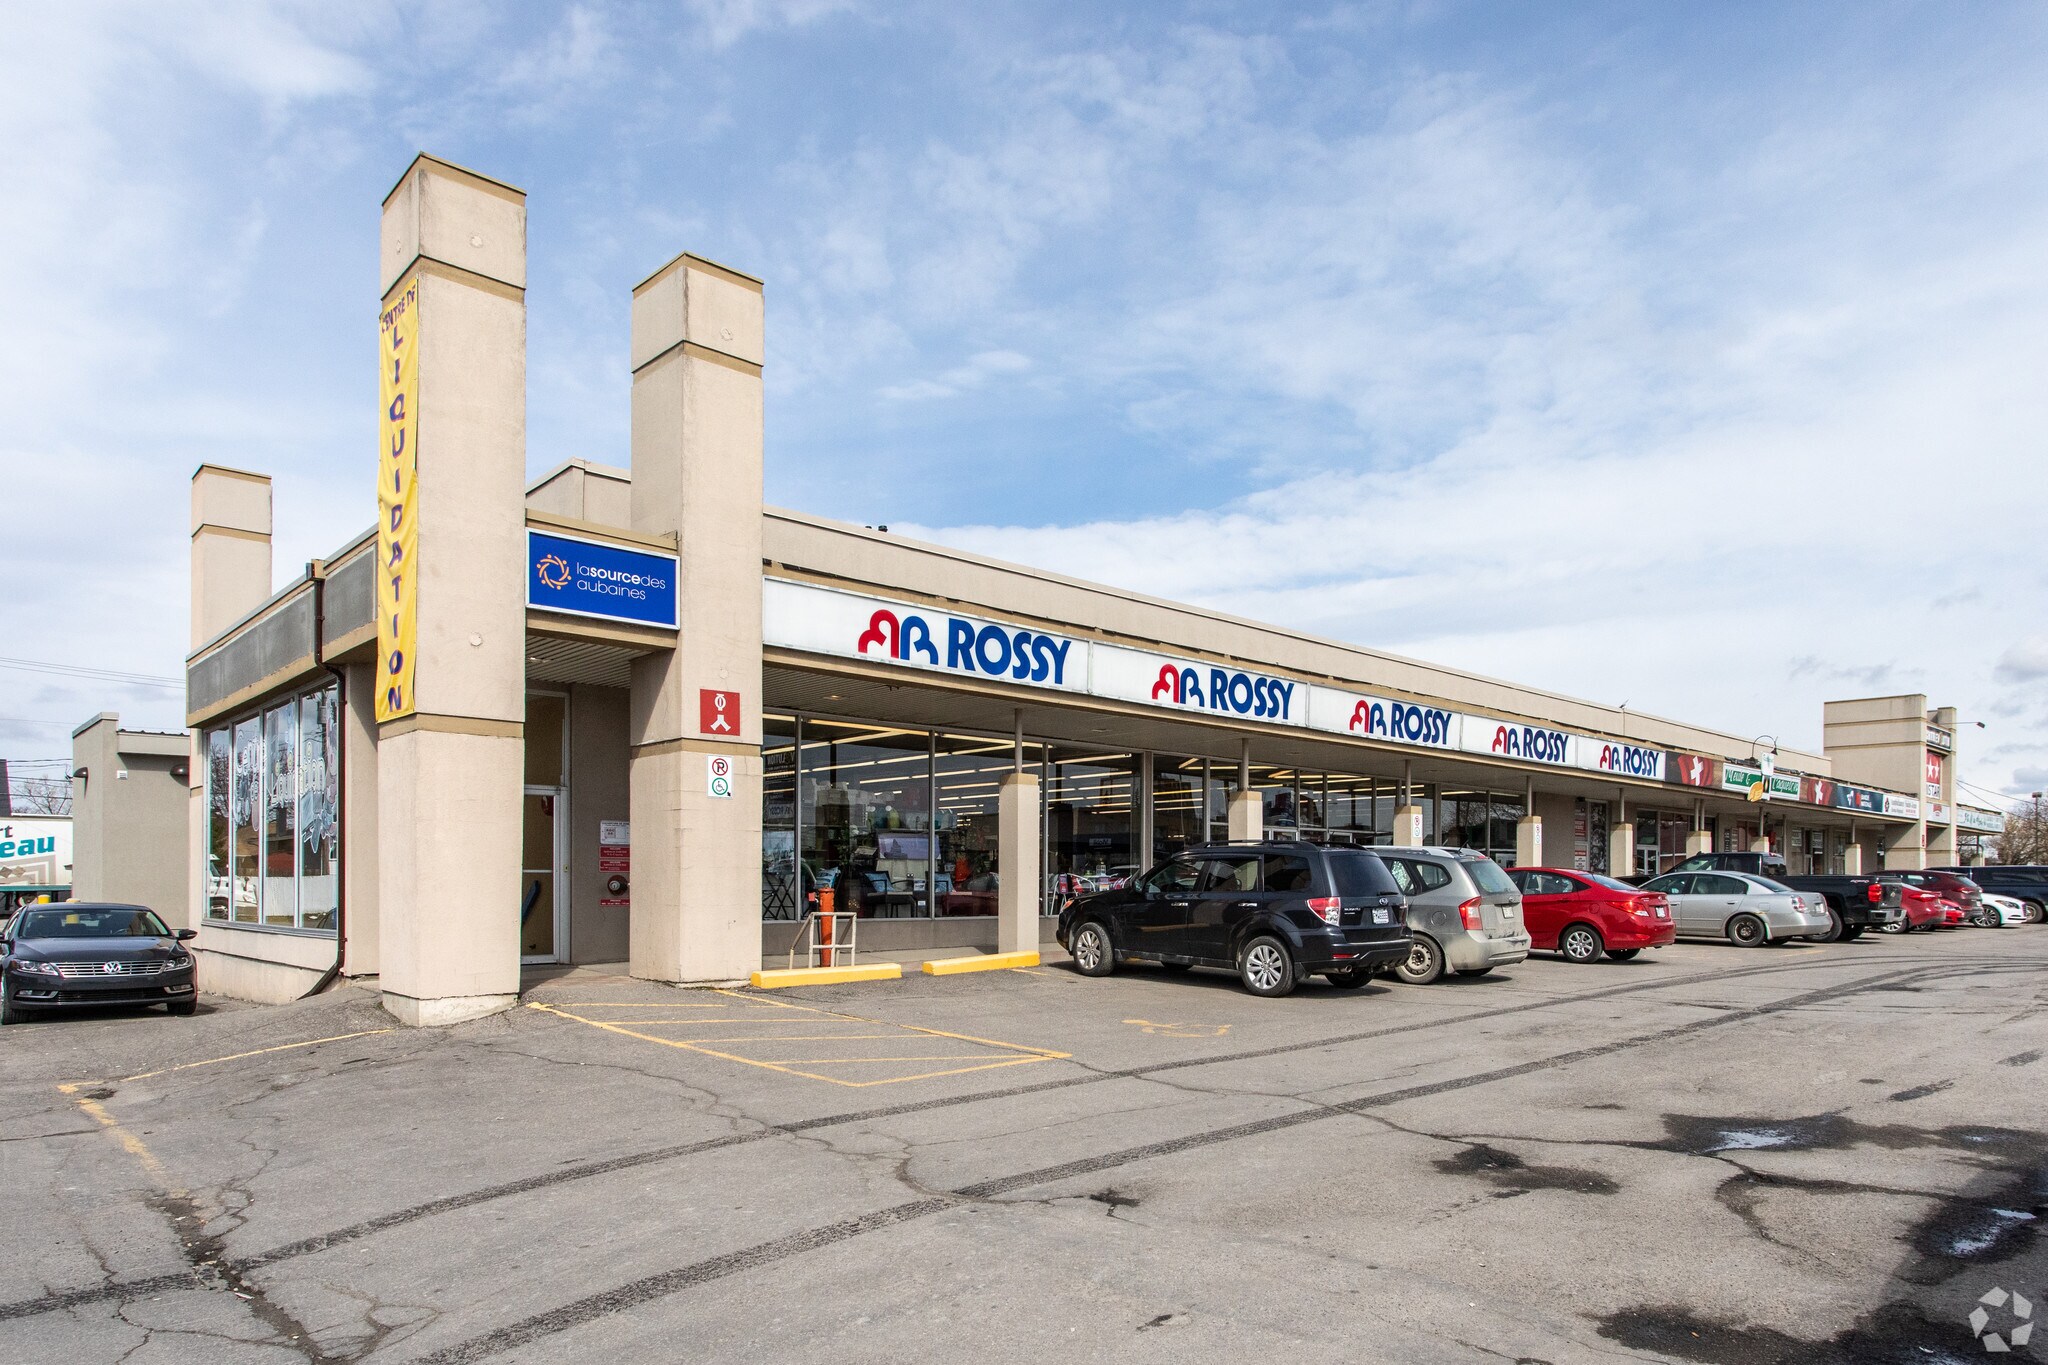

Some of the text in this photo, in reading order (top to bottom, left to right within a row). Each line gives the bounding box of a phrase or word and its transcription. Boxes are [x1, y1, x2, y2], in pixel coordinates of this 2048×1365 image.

[388, 324, 407, 712] LIQUIDATION
[577, 580, 646, 600] aubaines
[948, 617, 1072, 685] ROSSY
[1210, 669, 1295, 720] ROSSY
[1391, 702, 1452, 745] ROSSY
[1523, 727, 1569, 763] ROSSY
[1623, 747, 1659, 777] ROSSY
